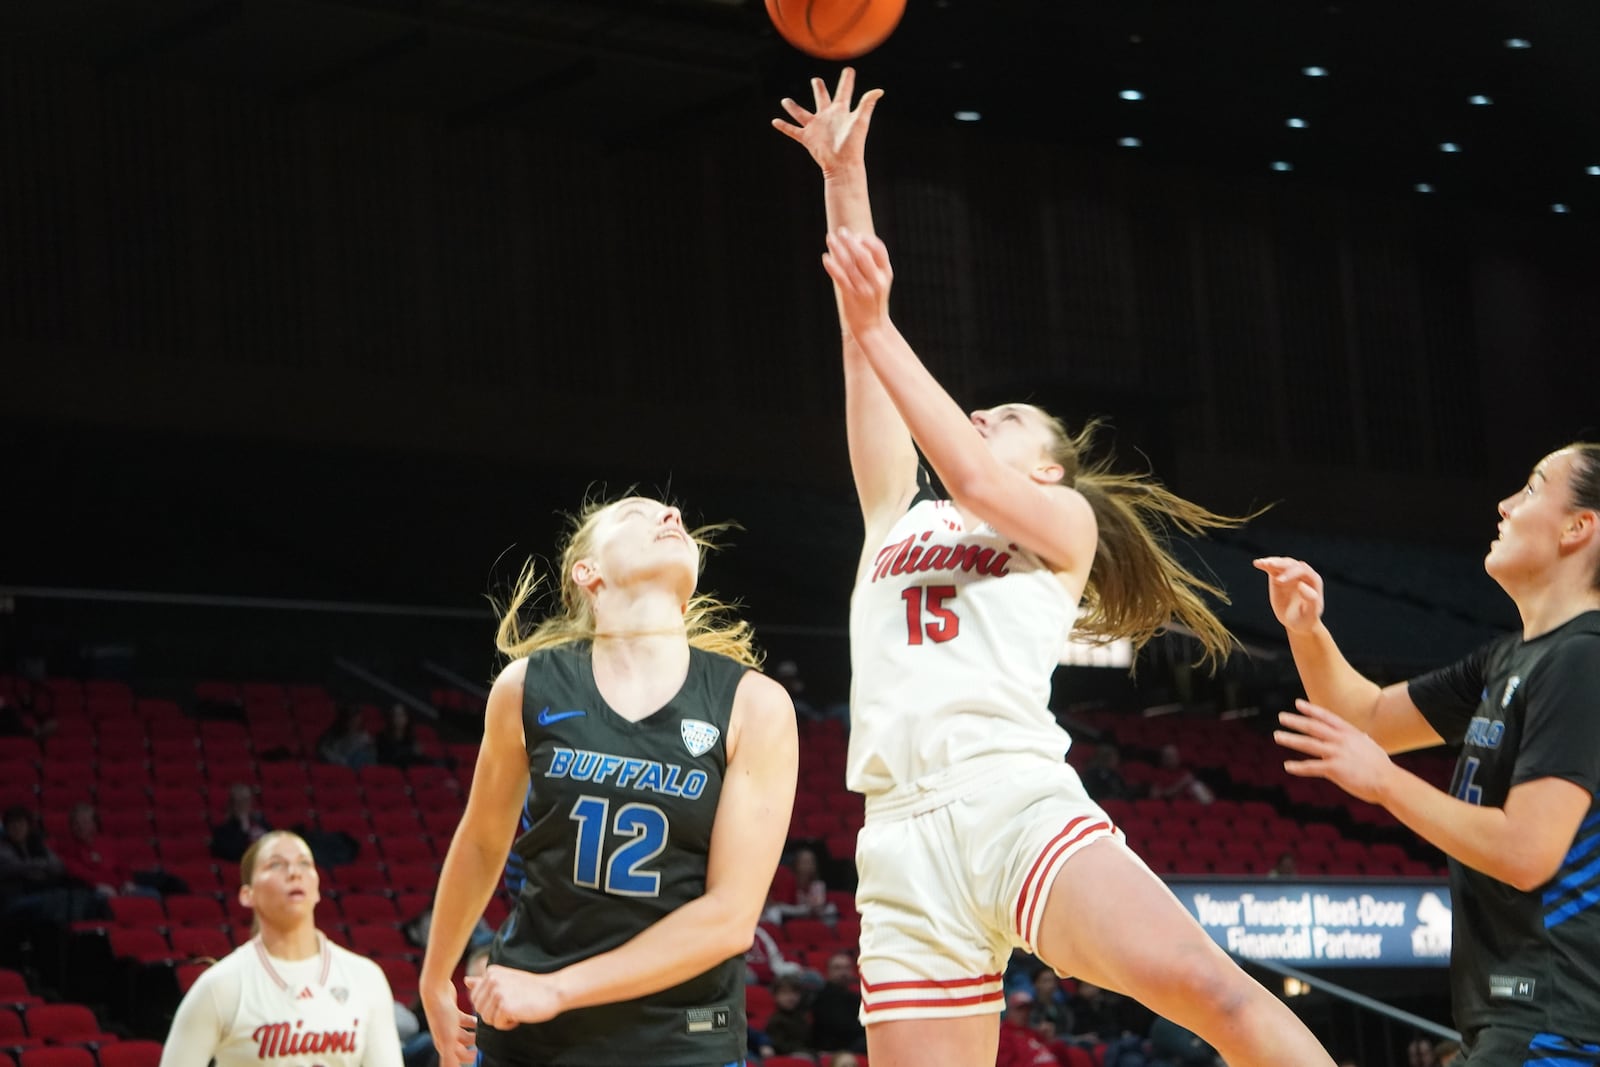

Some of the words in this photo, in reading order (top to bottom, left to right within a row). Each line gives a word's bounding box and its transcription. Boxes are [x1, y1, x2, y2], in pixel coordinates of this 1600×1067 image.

[872, 530, 1018, 583] Miami
[901, 585, 960, 646] 15
[545, 747, 708, 800] BUFFALO
[569, 794, 670, 898] 12
[1193, 893, 1240, 926] Your
[1240, 892, 1312, 926] Trusted
[1313, 894, 1406, 926] Next-Door
[1227, 926, 1312, 959] Financial
[1312, 926, 1383, 959] Partner
[1519, 982, 1529, 995] M
[252, 1018, 359, 1060] Miami
